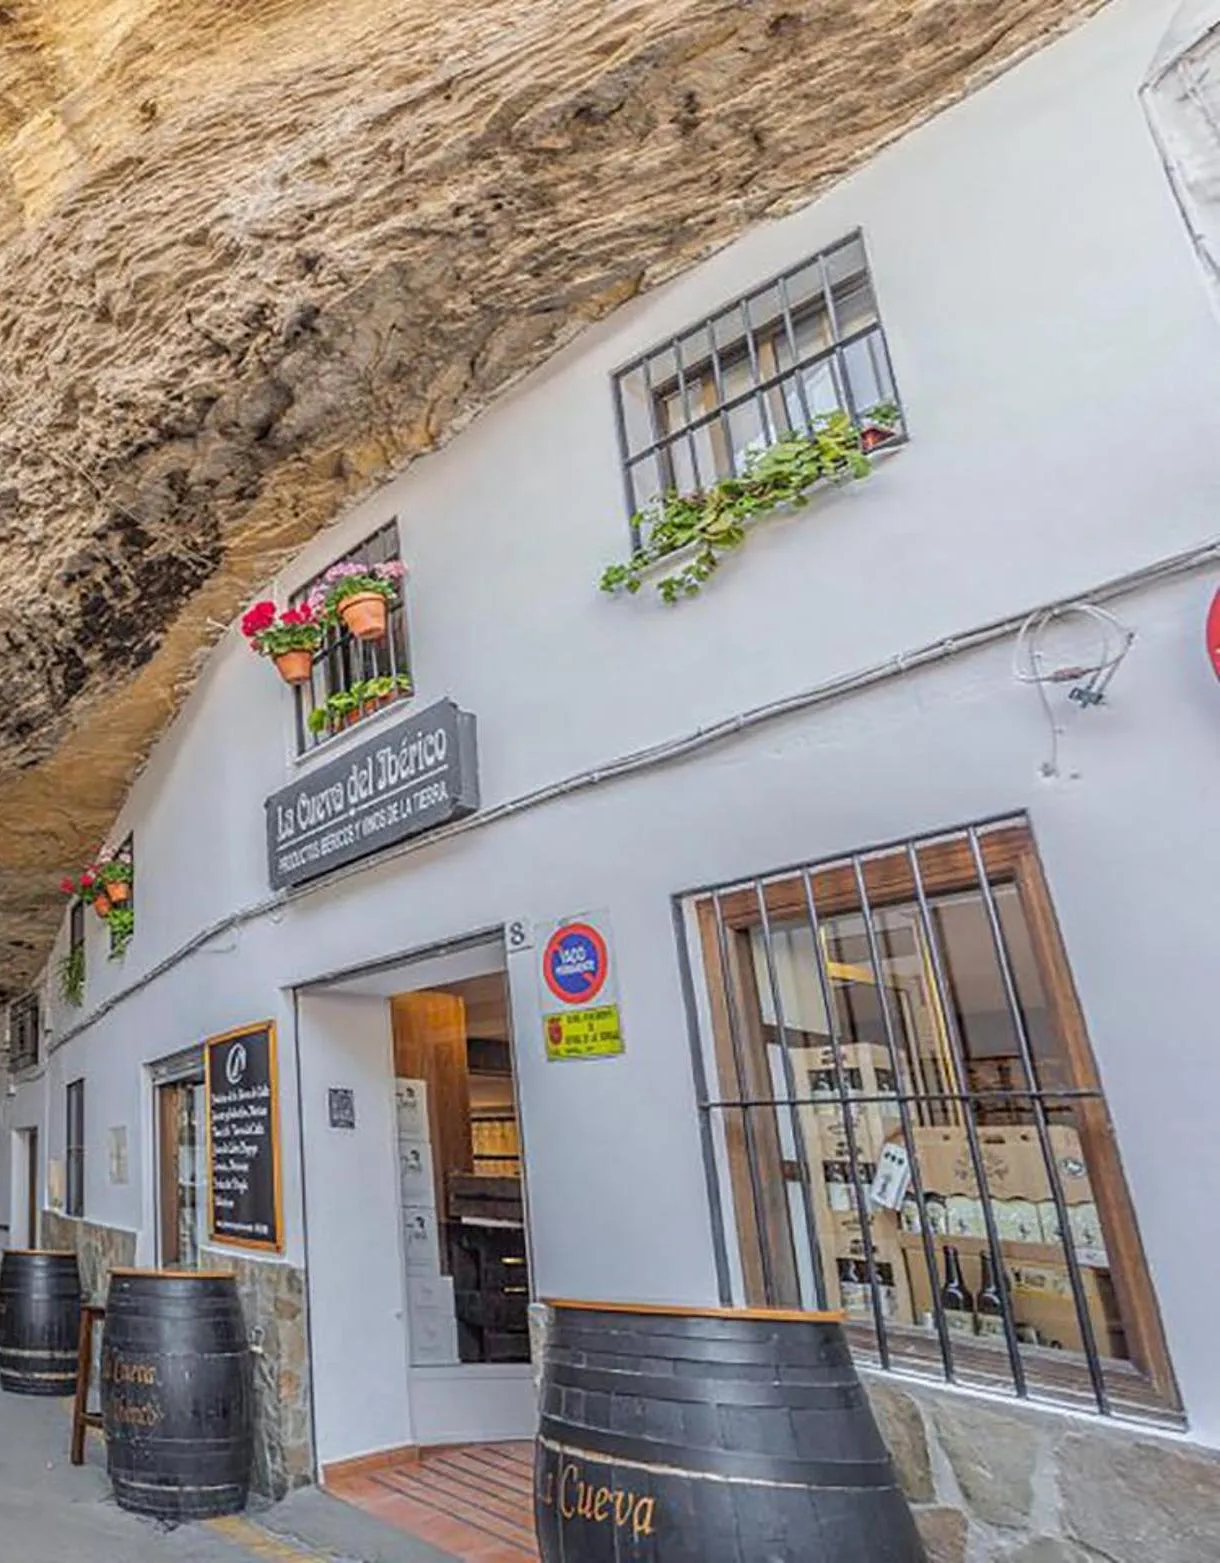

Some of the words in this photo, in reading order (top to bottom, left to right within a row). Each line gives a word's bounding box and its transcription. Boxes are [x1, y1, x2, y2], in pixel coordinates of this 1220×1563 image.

[276, 804, 295, 842] La
[296, 781, 345, 831] Cueva
[347, 757, 374, 804] del
[376, 727, 447, 790] Ibérico
[510, 921, 525, 946] 8
[560, 1463, 655, 1537] Cueva
